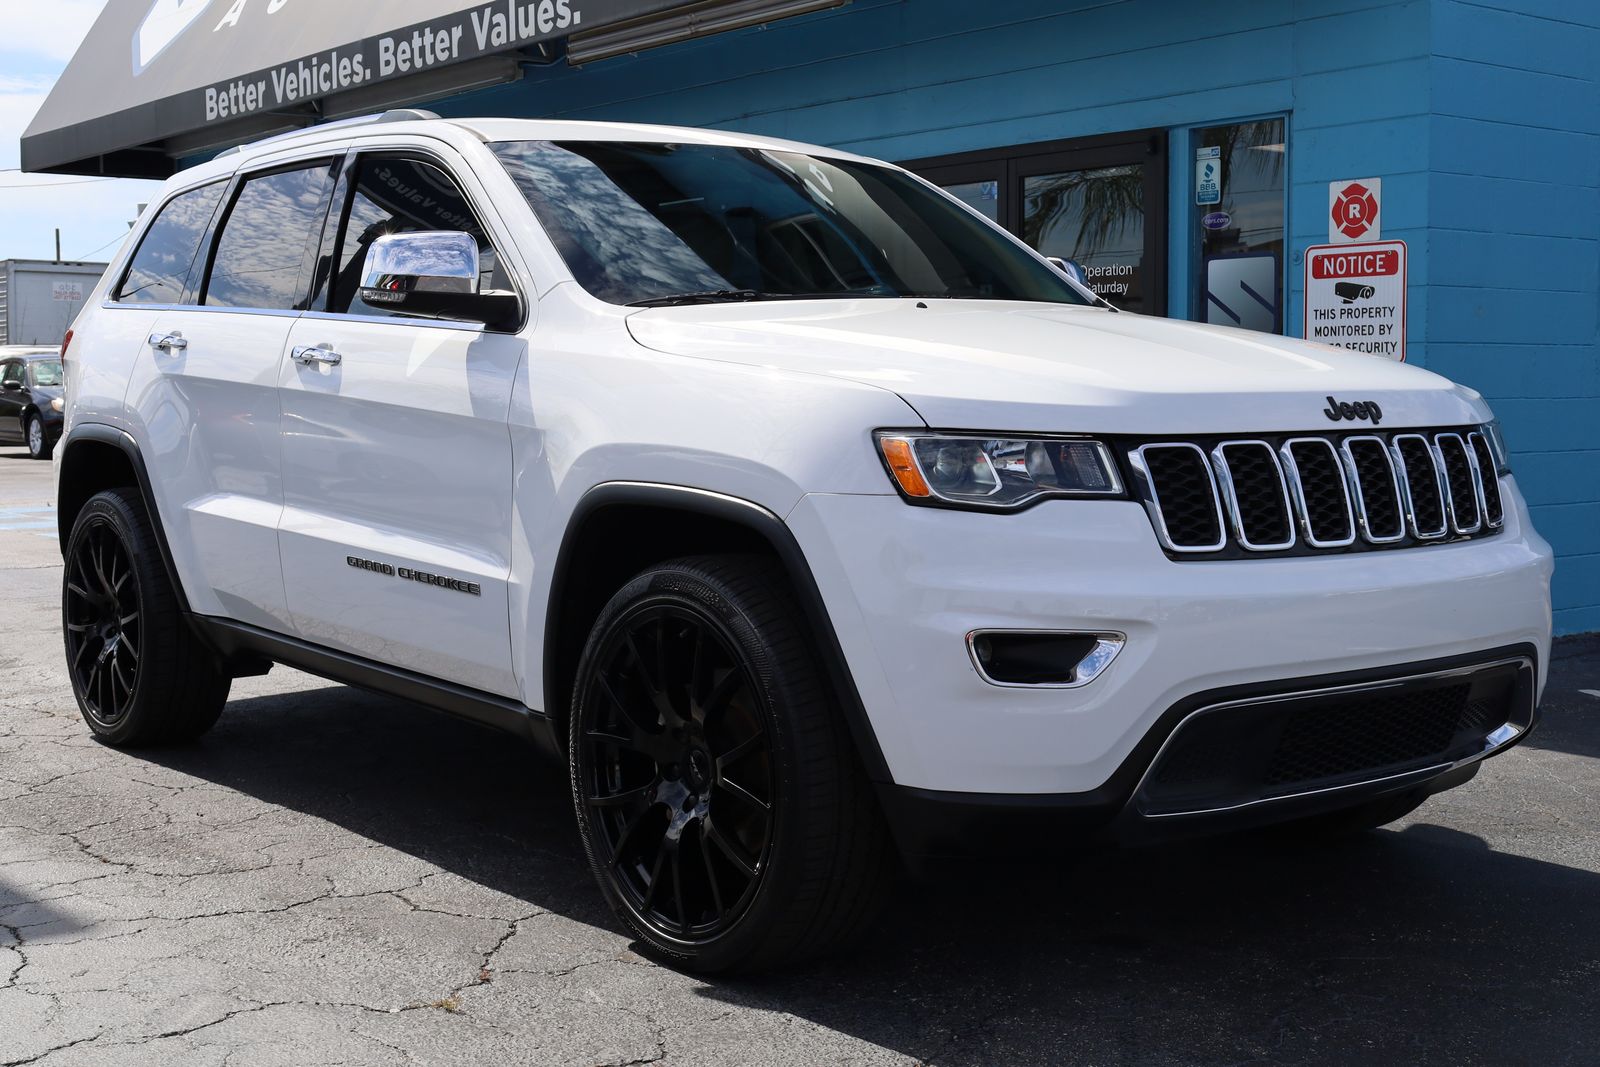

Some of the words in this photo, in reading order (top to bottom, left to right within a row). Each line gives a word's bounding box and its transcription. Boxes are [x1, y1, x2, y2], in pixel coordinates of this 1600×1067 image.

[205, 87, 266, 121] Better
[271, 52, 371, 104] Vehicles.
[379, 27, 463, 77] Better
[471, 0, 581, 51] Values.
[1200, 183, 1217, 191] BBB
[1348, 203, 1361, 219] R
[1323, 254, 1387, 276] NOTICE
[1313, 308, 1336, 320] THIS
[1340, 306, 1395, 319] PROPERTY
[1315, 325, 1375, 337] MONITORED
[1379, 323, 1394, 336] BY
[1323, 395, 1383, 425] Jeep
[347, 556, 395, 577] GRAND
[398, 567, 481, 597] CHEROKEE
